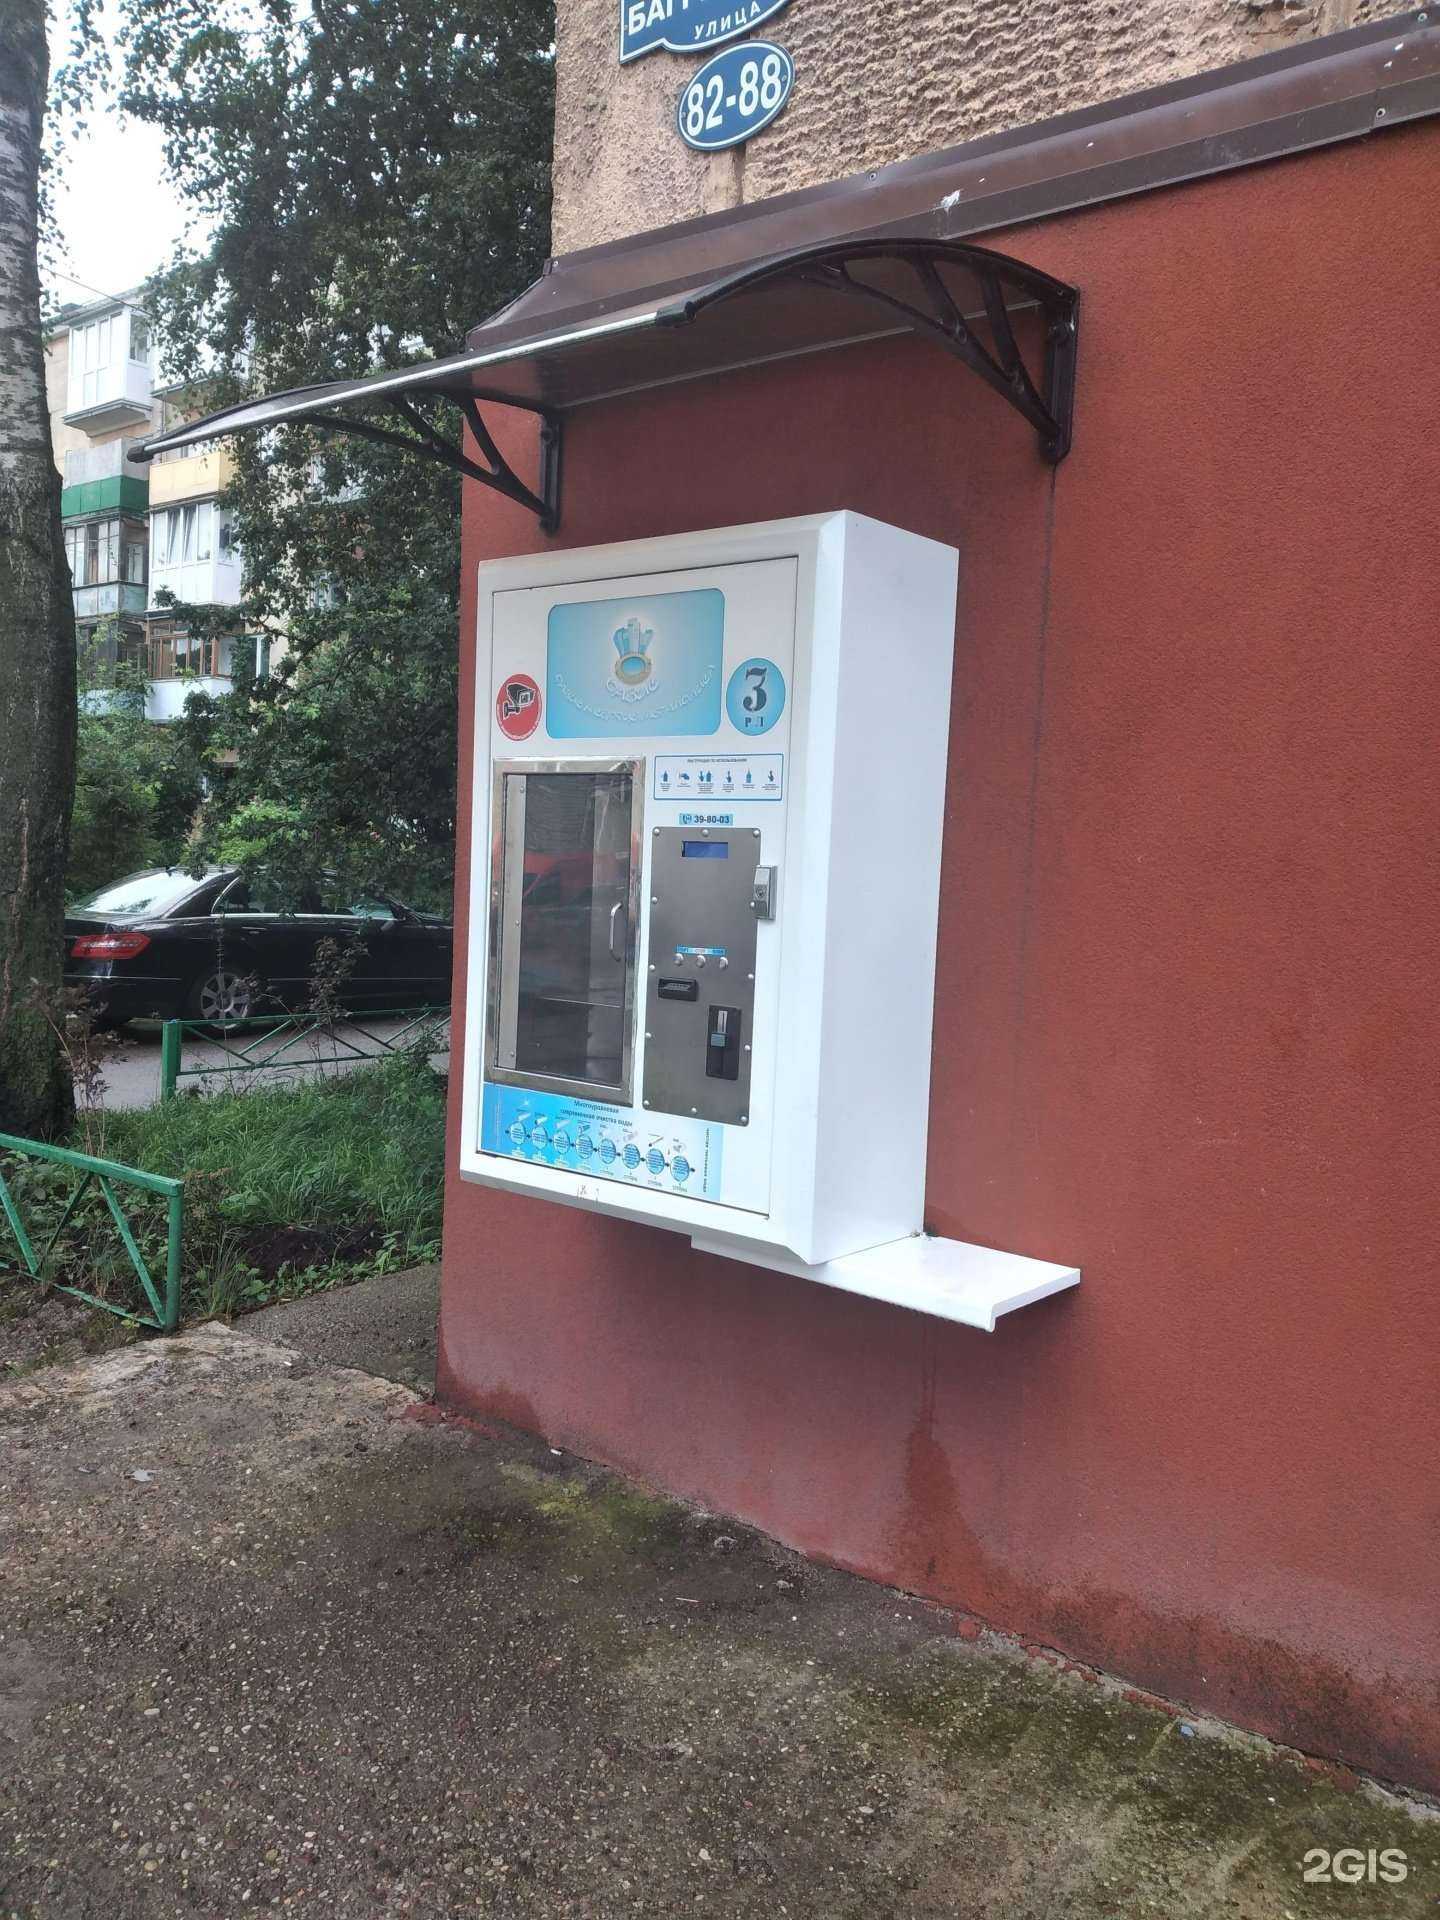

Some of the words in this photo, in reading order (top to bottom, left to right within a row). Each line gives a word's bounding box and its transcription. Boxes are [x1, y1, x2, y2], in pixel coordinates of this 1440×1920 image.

[694, 2, 761, 40] УЛИЦА
[686, 54, 782, 137] 82-88
[743, 667, 767, 711] 3
[694, 815, 730, 824] 39-80-03
